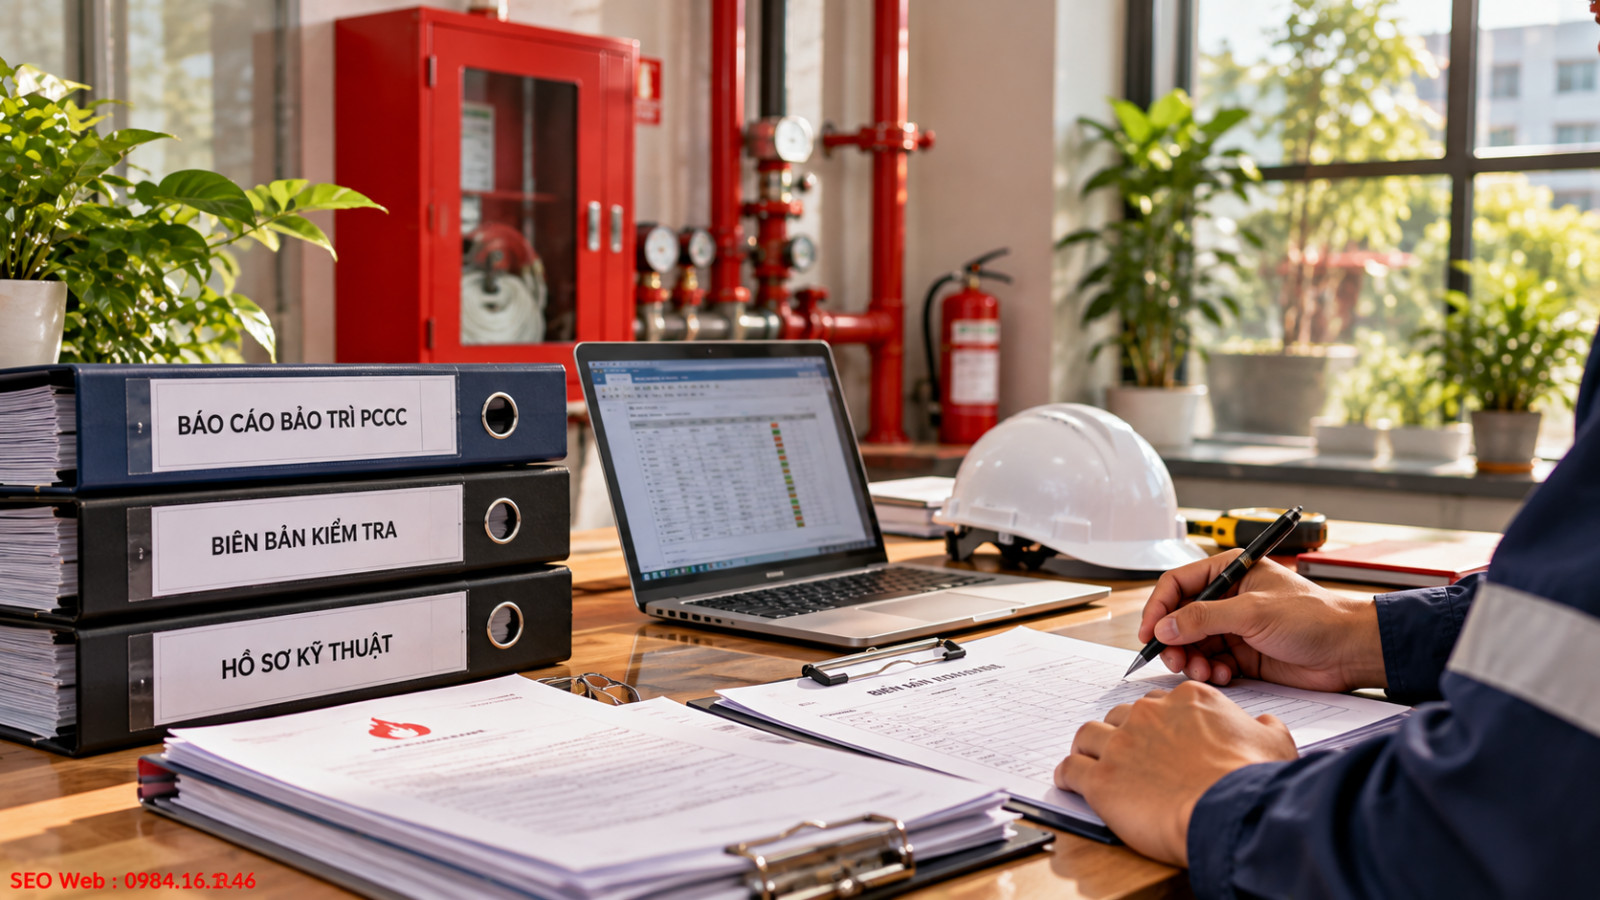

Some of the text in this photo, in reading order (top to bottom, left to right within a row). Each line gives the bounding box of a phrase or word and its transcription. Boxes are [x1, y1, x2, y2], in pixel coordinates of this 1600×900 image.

[177, 404, 408, 436] BÁO CÁO BẢO TRÌ PCCC
[211, 517, 398, 556] BIÊN BẢN KIỂM TRA
[221, 631, 393, 680] HỒ SƠ KỸ THUẬT
